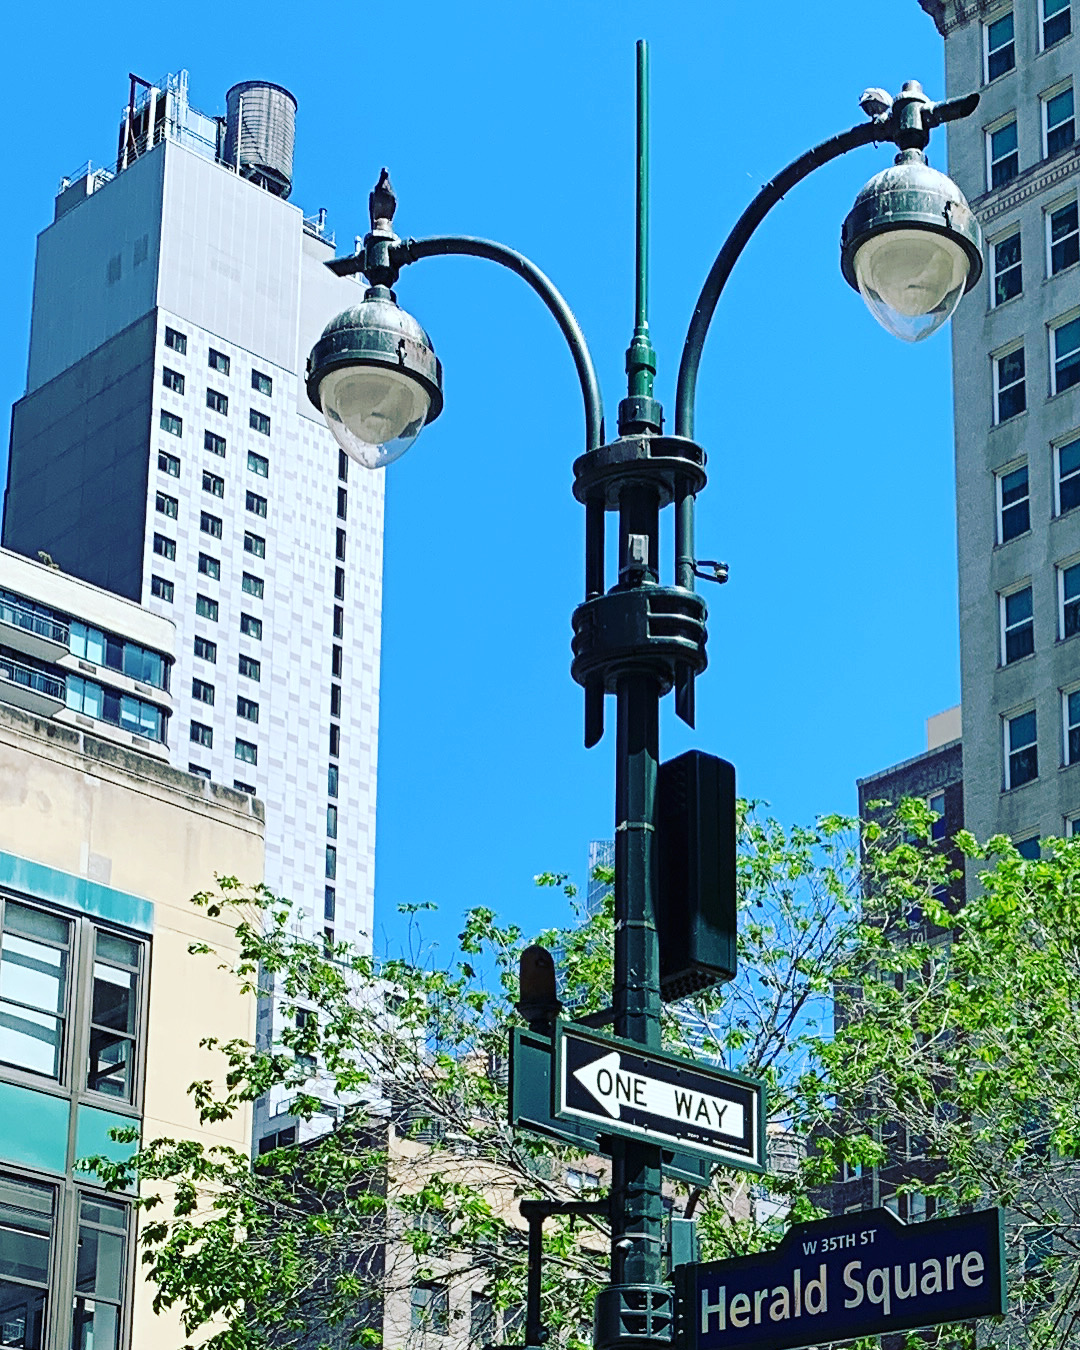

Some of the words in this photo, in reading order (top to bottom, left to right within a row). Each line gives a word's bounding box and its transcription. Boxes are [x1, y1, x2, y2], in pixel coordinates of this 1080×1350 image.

[596, 1068, 648, 1107] ONE
[674, 1089, 729, 1129] WAY
[802, 1241, 817, 1256] W
[821, 1233, 857, 1252] 35TH
[860, 1229, 878, 1245] ST
[700, 1263, 829, 1334] Herald
[842, 1249, 986, 1316] Square
